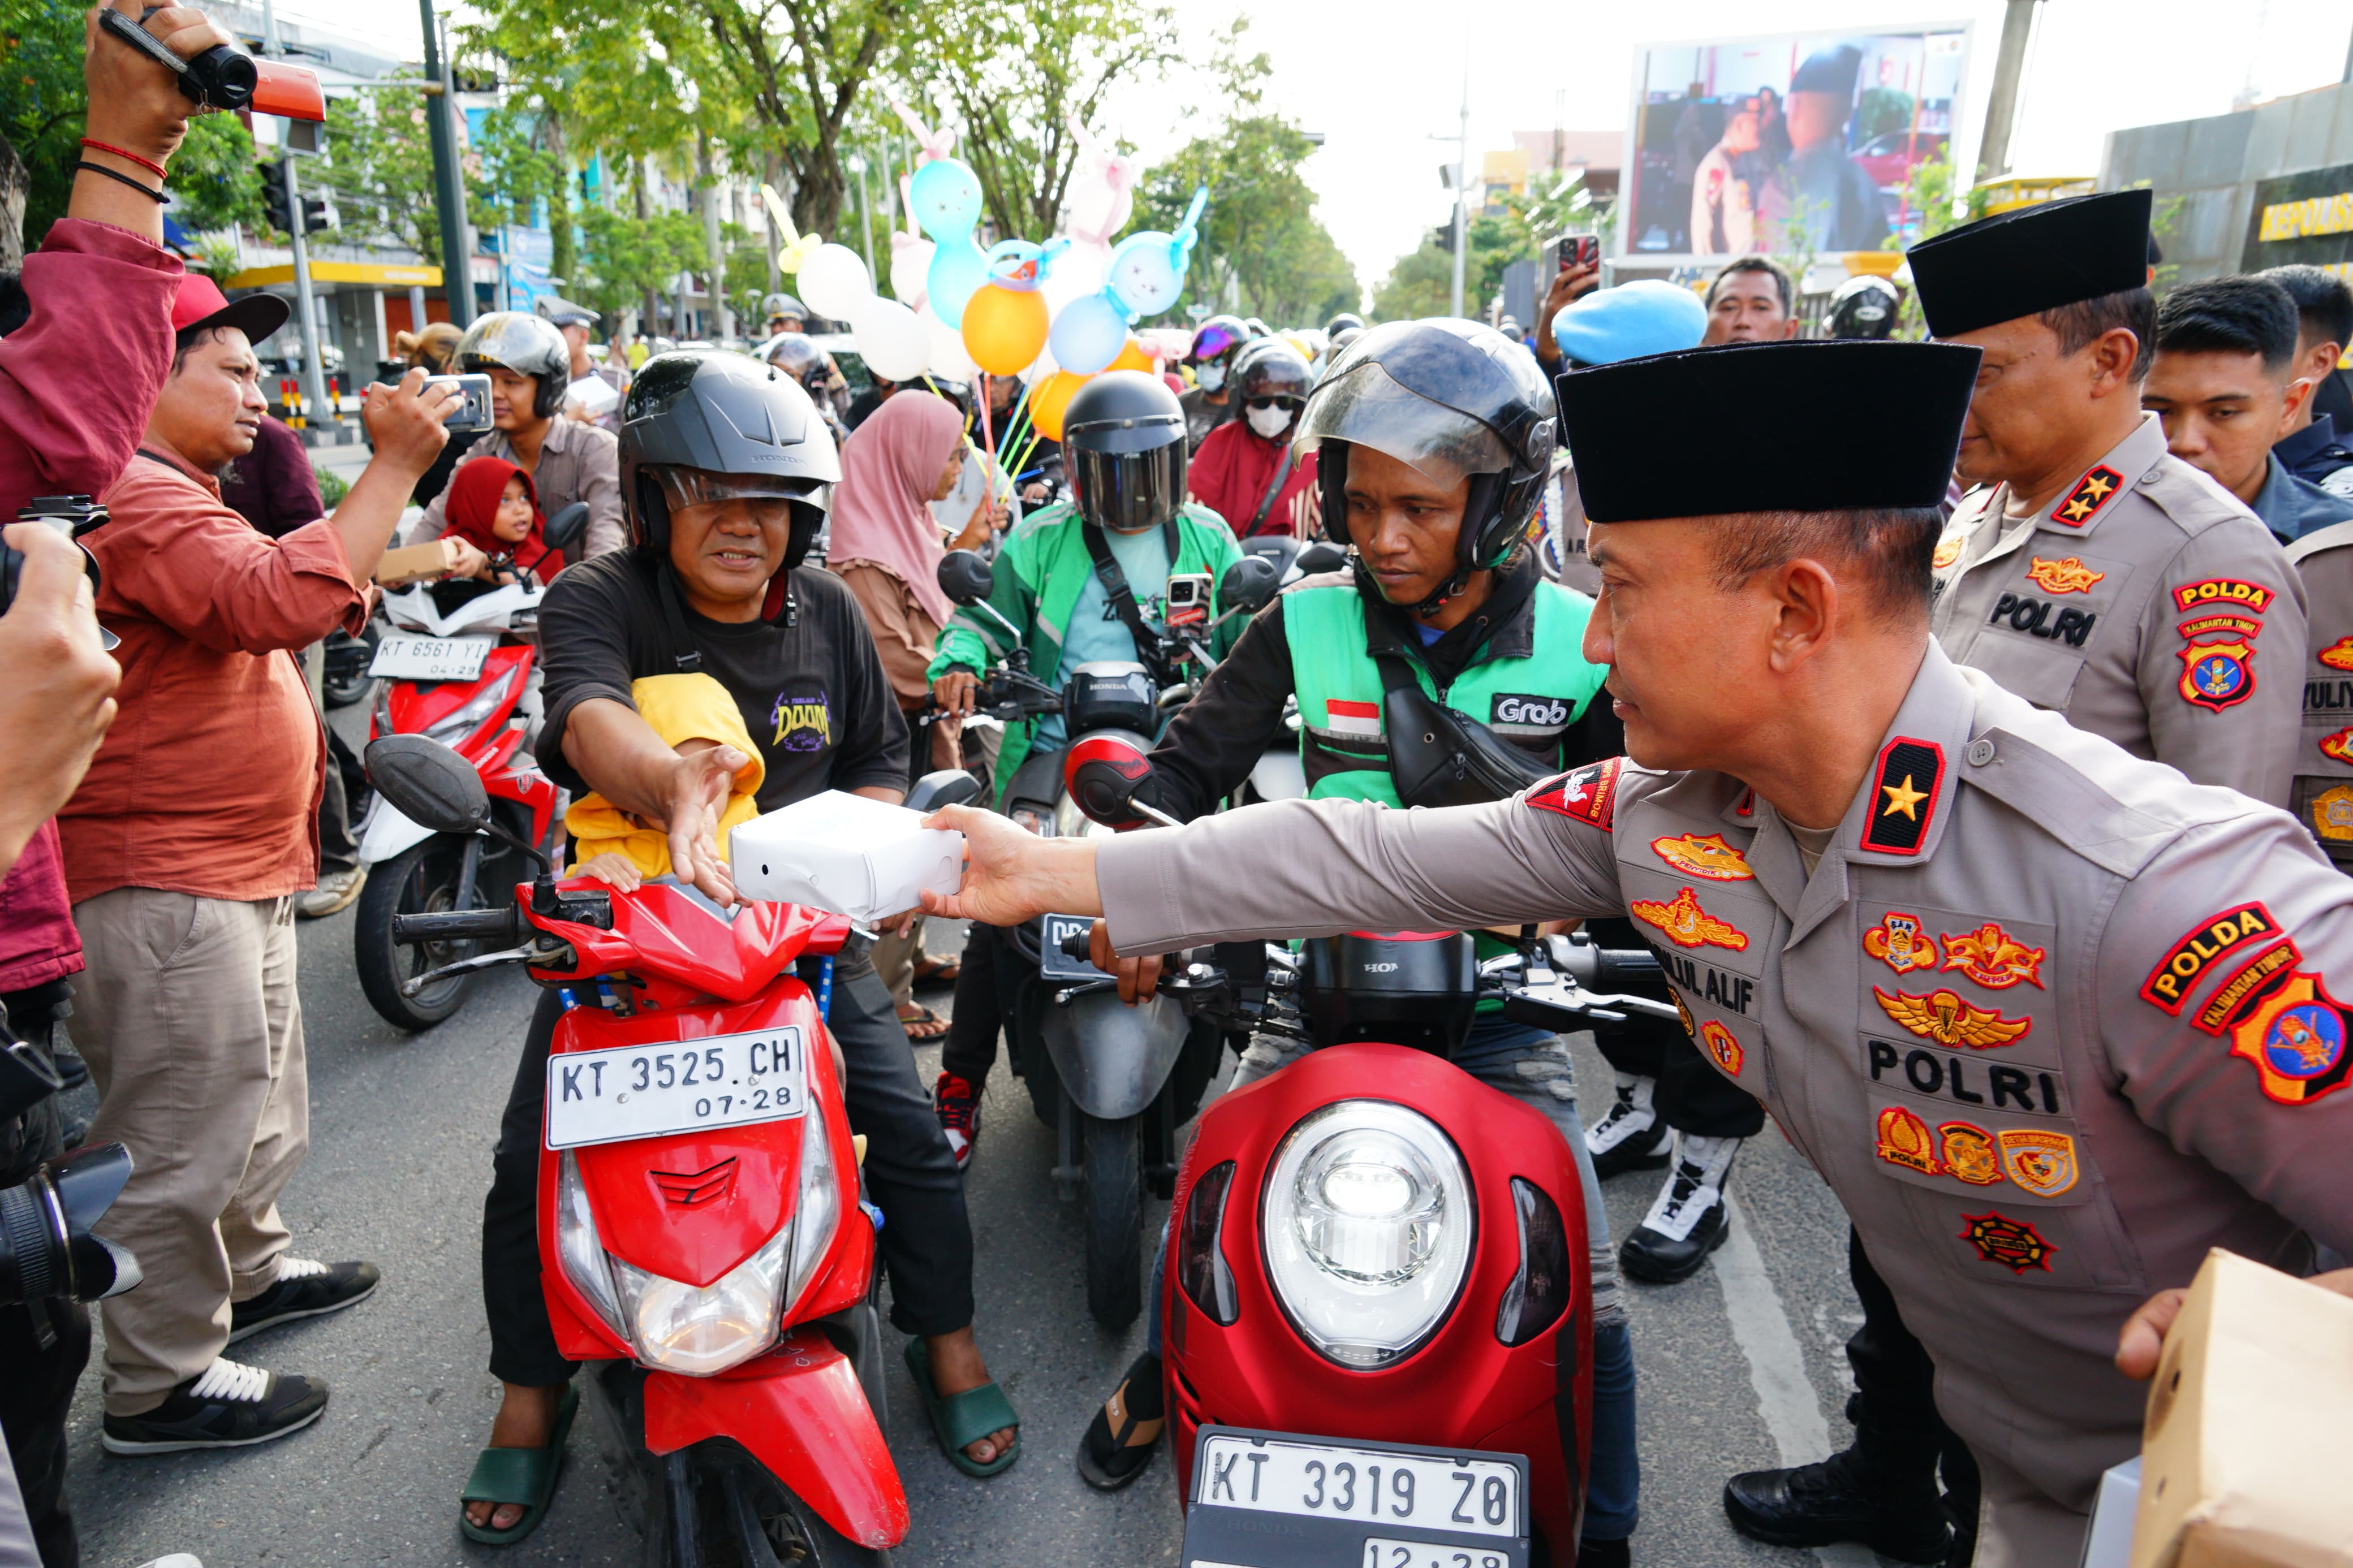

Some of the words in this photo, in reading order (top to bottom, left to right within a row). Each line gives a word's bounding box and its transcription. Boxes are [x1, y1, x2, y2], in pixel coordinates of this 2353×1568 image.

[2258, 192, 2353, 242] KEPOLIS
[2181, 581, 2264, 607] POLDA
[1990, 593, 2096, 646] POLRI
[2185, 618, 2233, 633] KALIMANTAN
[2235, 619, 2256, 633] TIMUR
[381, 641, 403, 656] KT
[412, 642, 453, 657] 6561
[773, 705, 831, 746] DOOM
[1498, 698, 1567, 724] Grab
[1591, 780, 1609, 818] BRIMOB
[2155, 911, 2265, 998] POLDA
[1706, 969, 1753, 1014] ALIF
[2202, 967, 2262, 1026] KALIMANTAN
[563, 1061, 607, 1102] KT
[632, 1048, 724, 1091] 3525
[750, 1038, 790, 1075] CH
[1869, 1040, 2059, 1114] POLRI
[1890, 1151, 1927, 1169] POLRI
[1212, 1452, 1269, 1502] KT
[1303, 1460, 1415, 1518] 3319
